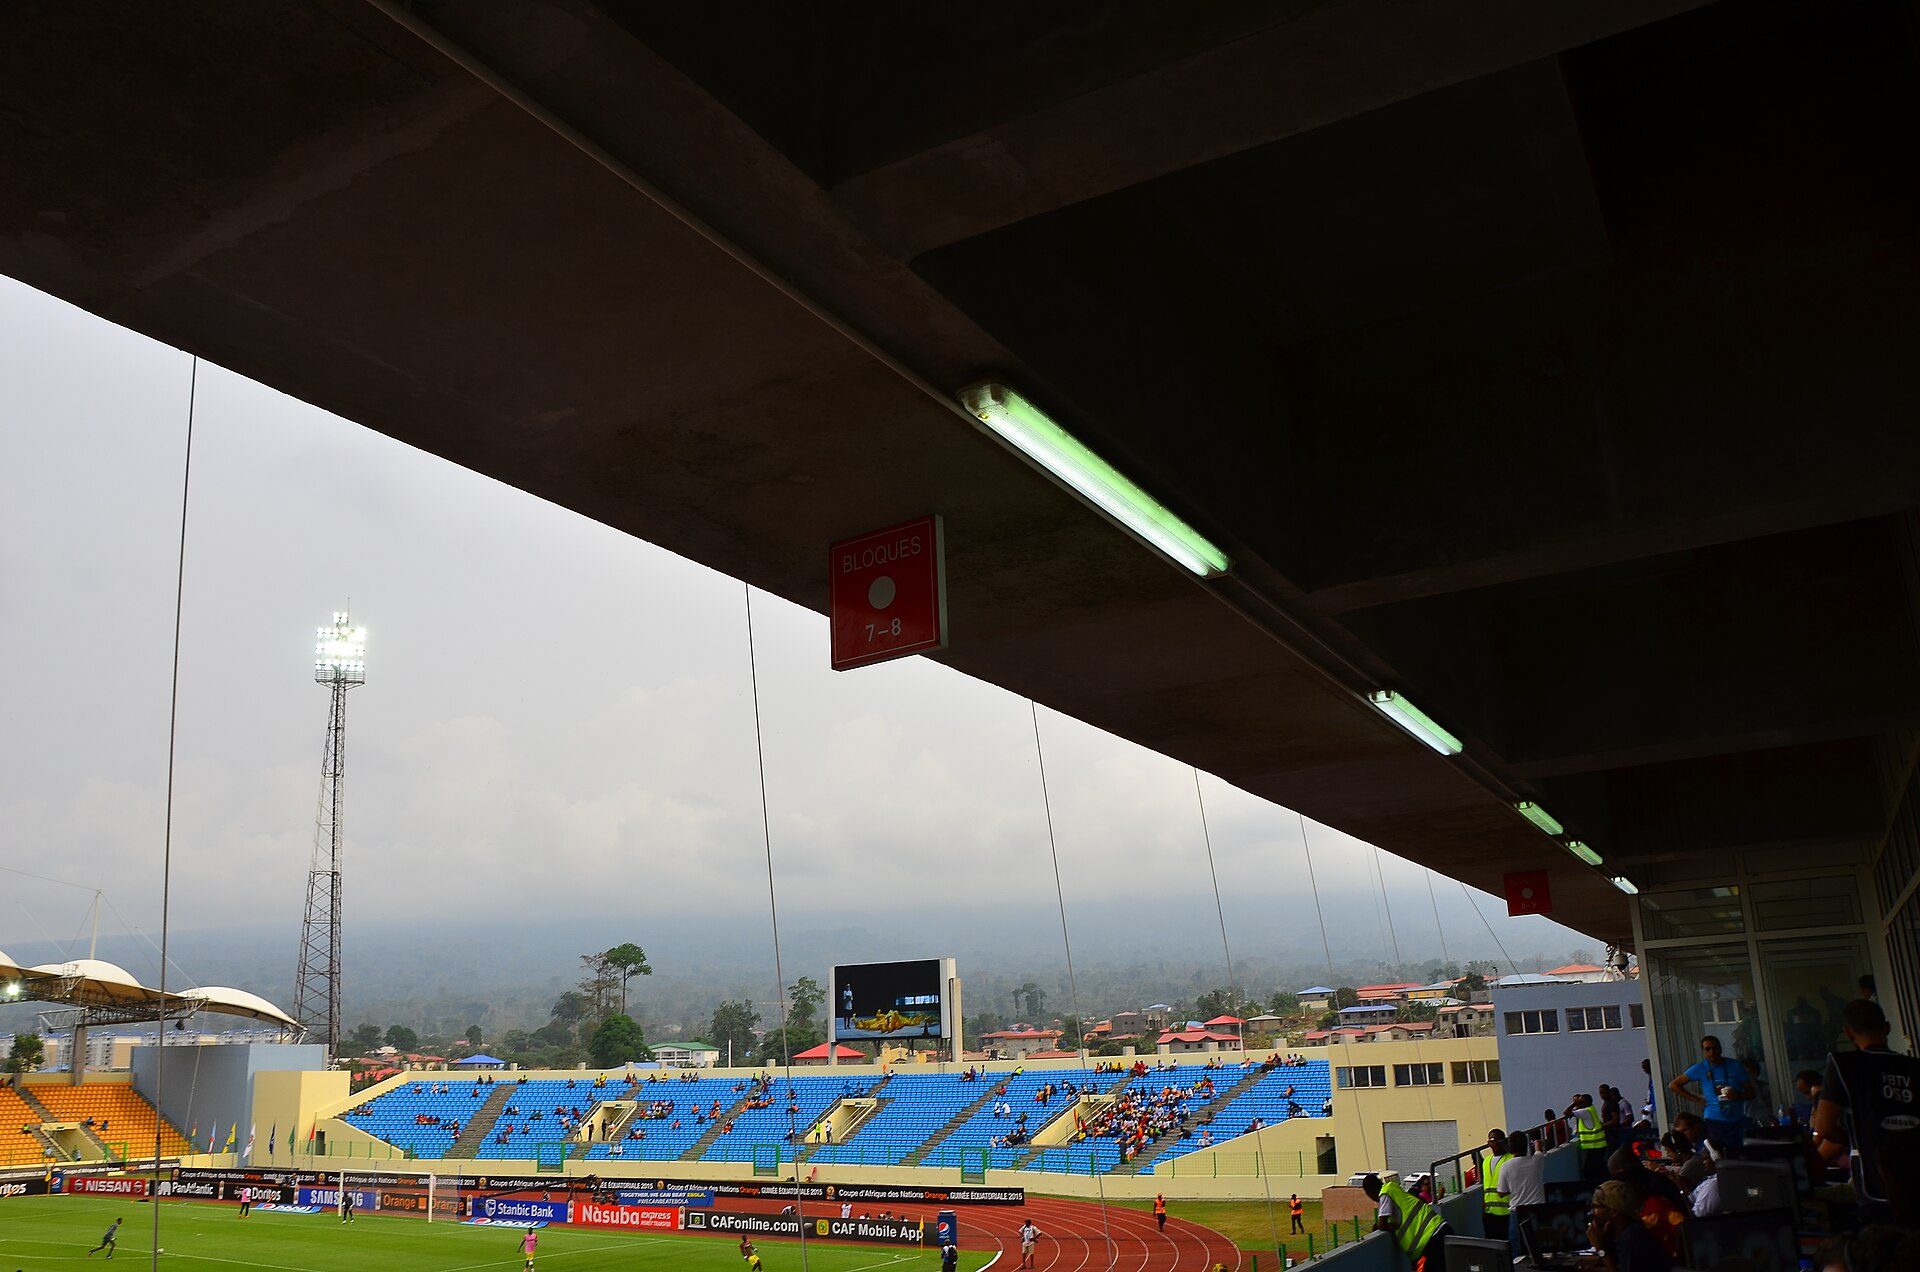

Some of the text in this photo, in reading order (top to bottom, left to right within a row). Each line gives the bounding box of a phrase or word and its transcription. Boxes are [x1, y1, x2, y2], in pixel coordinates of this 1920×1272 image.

[843, 536, 921, 574] BLOQUES
[865, 617, 902, 642] 7-8
[85, 1180, 131, 1192] NISSAN
[328, 1175, 342, 1183] Coup
[490, 1180, 508, 1188] Coupe
[172, 1181, 213, 1195] PanAtlantic
[252, 1187, 281, 1201] Doritos
[719, 1185, 739, 1193] Nations
[810, 1188, 823, 1196] 2015
[838, 1189, 859, 1198] Coupe
[859, 1189, 886, 1199] d'Afrique
[887, 1190, 899, 1198] des
[900, 1190, 924, 1199] Nations
[950, 1190, 970, 1200] GUINÉE
[970, 1191, 1007, 1200] ÉQUATORIALE
[383, 1194, 415, 1209] Orange
[497, 1203, 554, 1218] Stanbic Bank
[582, 1204, 640, 1225] Nàsuba
[641, 1211, 671, 1220] express
[710, 1215, 799, 1232] CAFonline.com
[832, 1221, 924, 1241] CAF Mobile App
